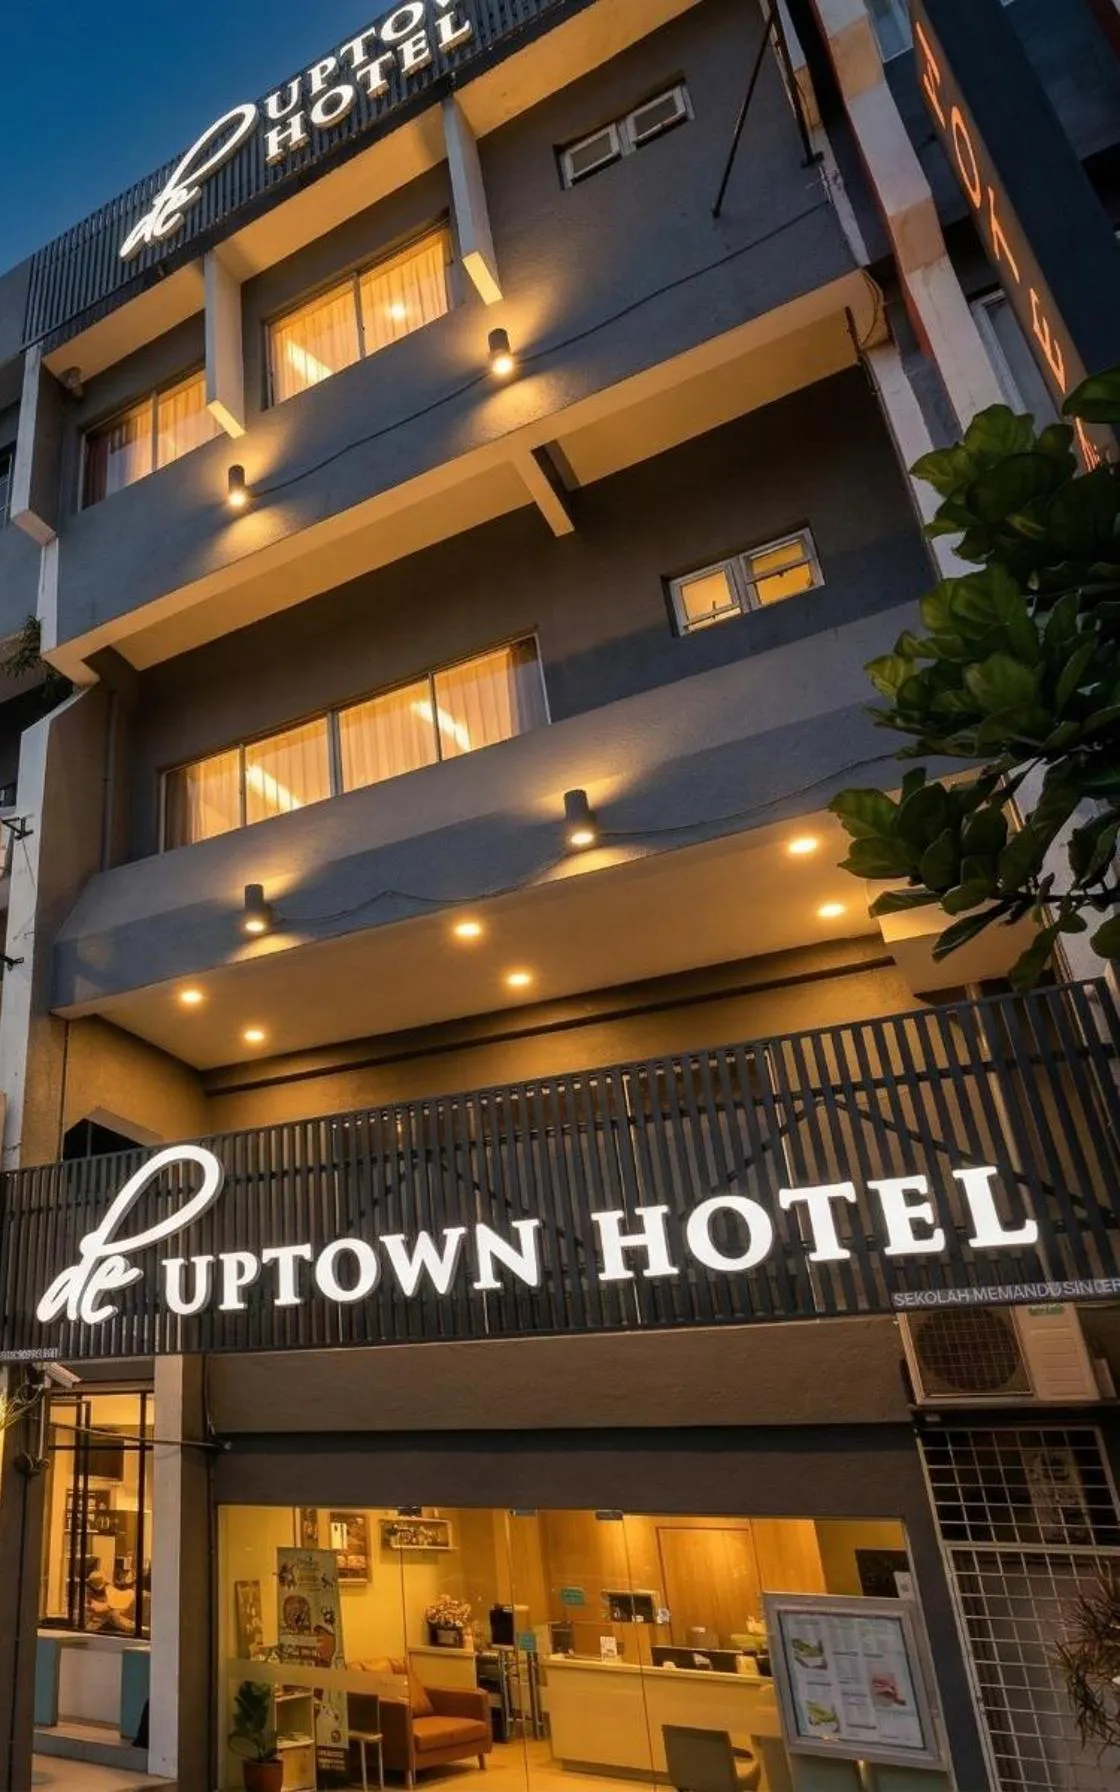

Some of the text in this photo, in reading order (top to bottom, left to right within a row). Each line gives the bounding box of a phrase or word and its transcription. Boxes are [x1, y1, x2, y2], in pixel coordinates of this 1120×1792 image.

[120, 0, 451, 260] de UPTO
[266, 11, 472, 164] HOTEL
[37, 1145, 1038, 1324] de UPTOWN HOTEL
[894, 1290, 970, 1306] SEKOLAH
[973, 1282, 1062, 1302] MEMANDU
